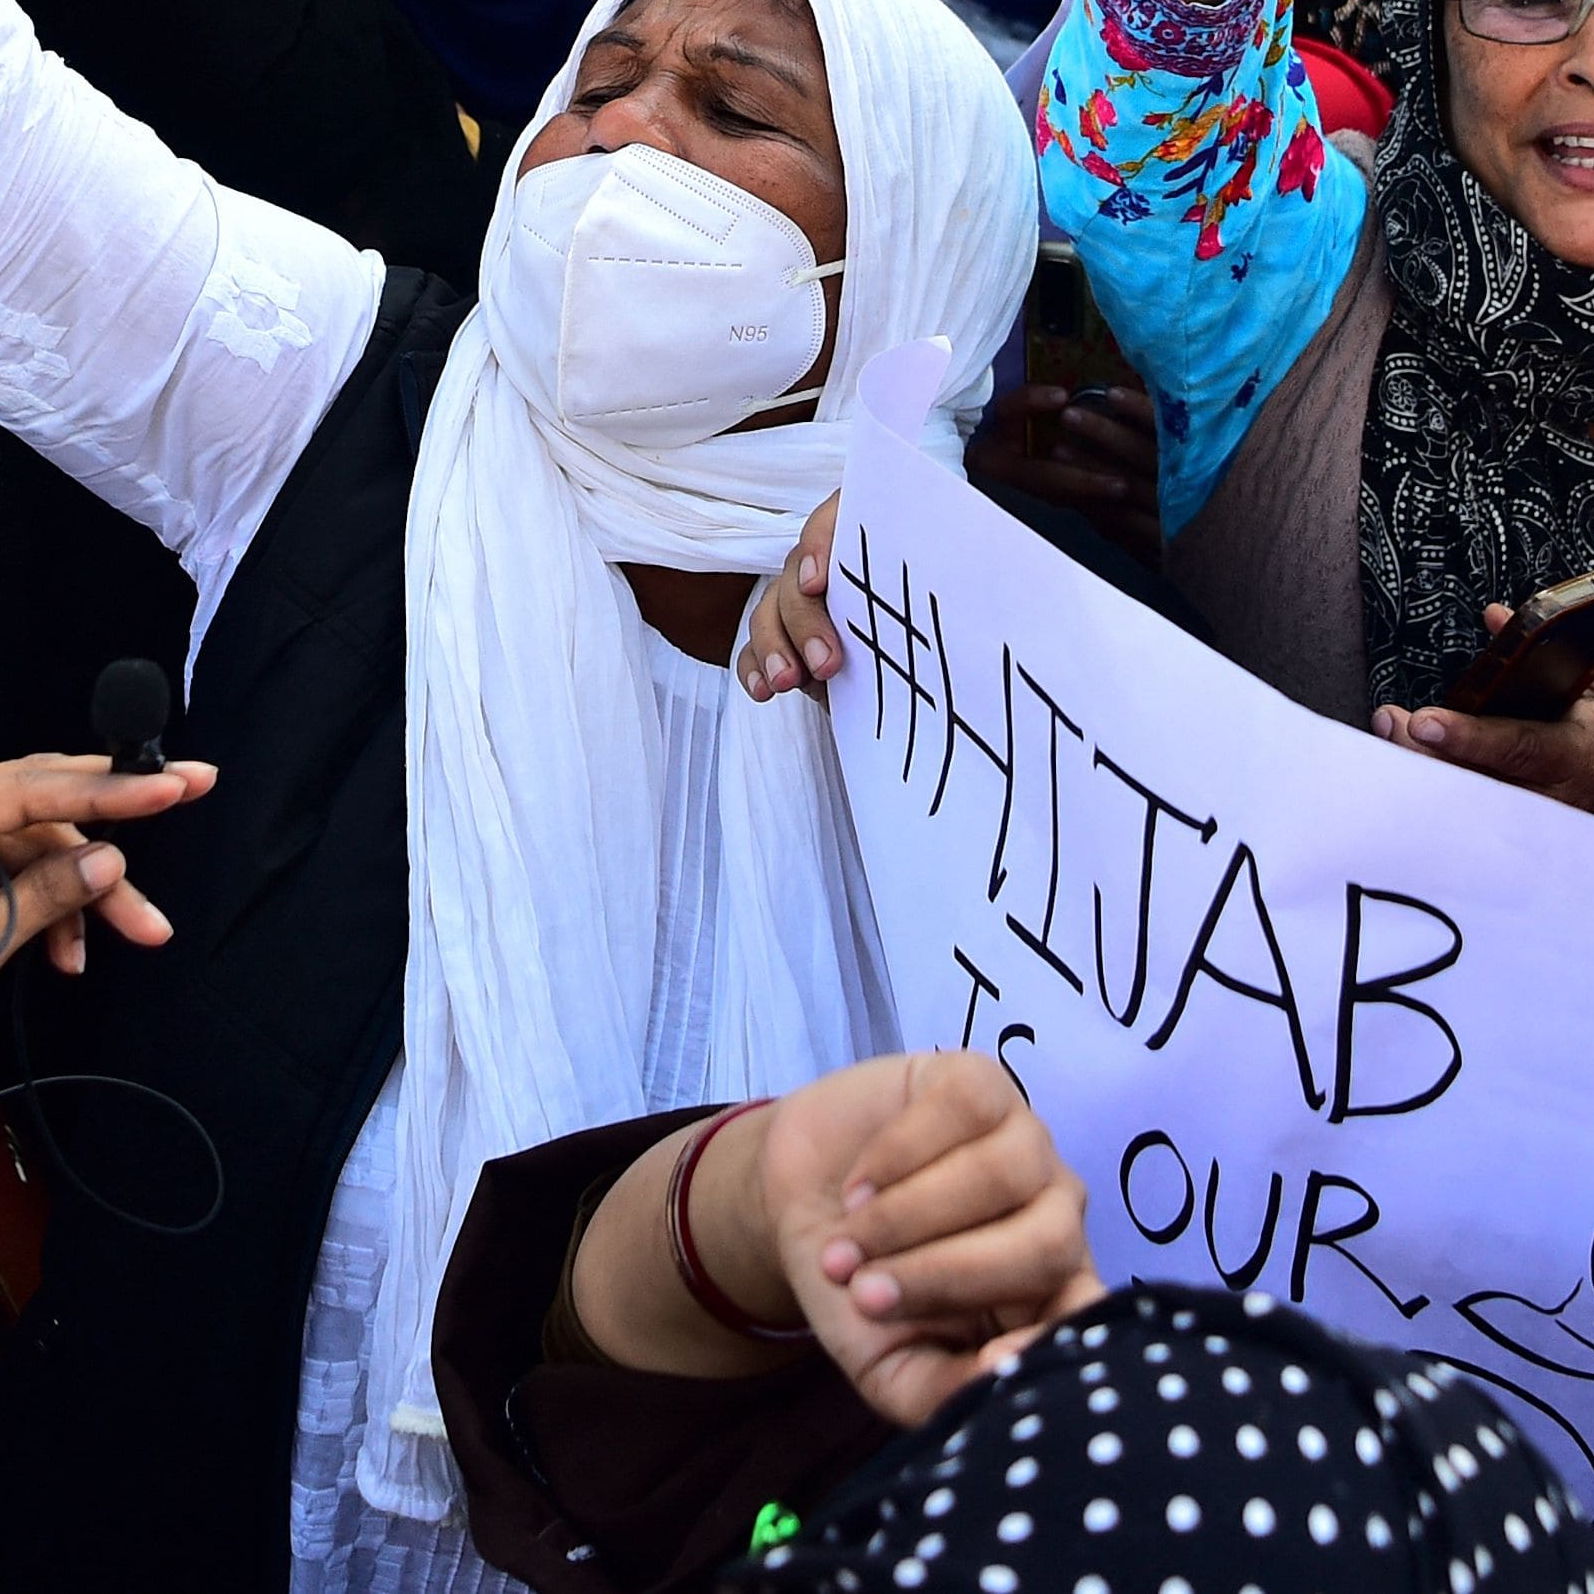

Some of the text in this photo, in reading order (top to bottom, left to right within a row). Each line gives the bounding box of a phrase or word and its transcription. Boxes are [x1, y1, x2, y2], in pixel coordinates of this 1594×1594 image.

[729, 325, 768, 342] N95
[841, 525, 1462, 1122] #HIJAB
[1118, 1129, 1430, 1318] OUR
